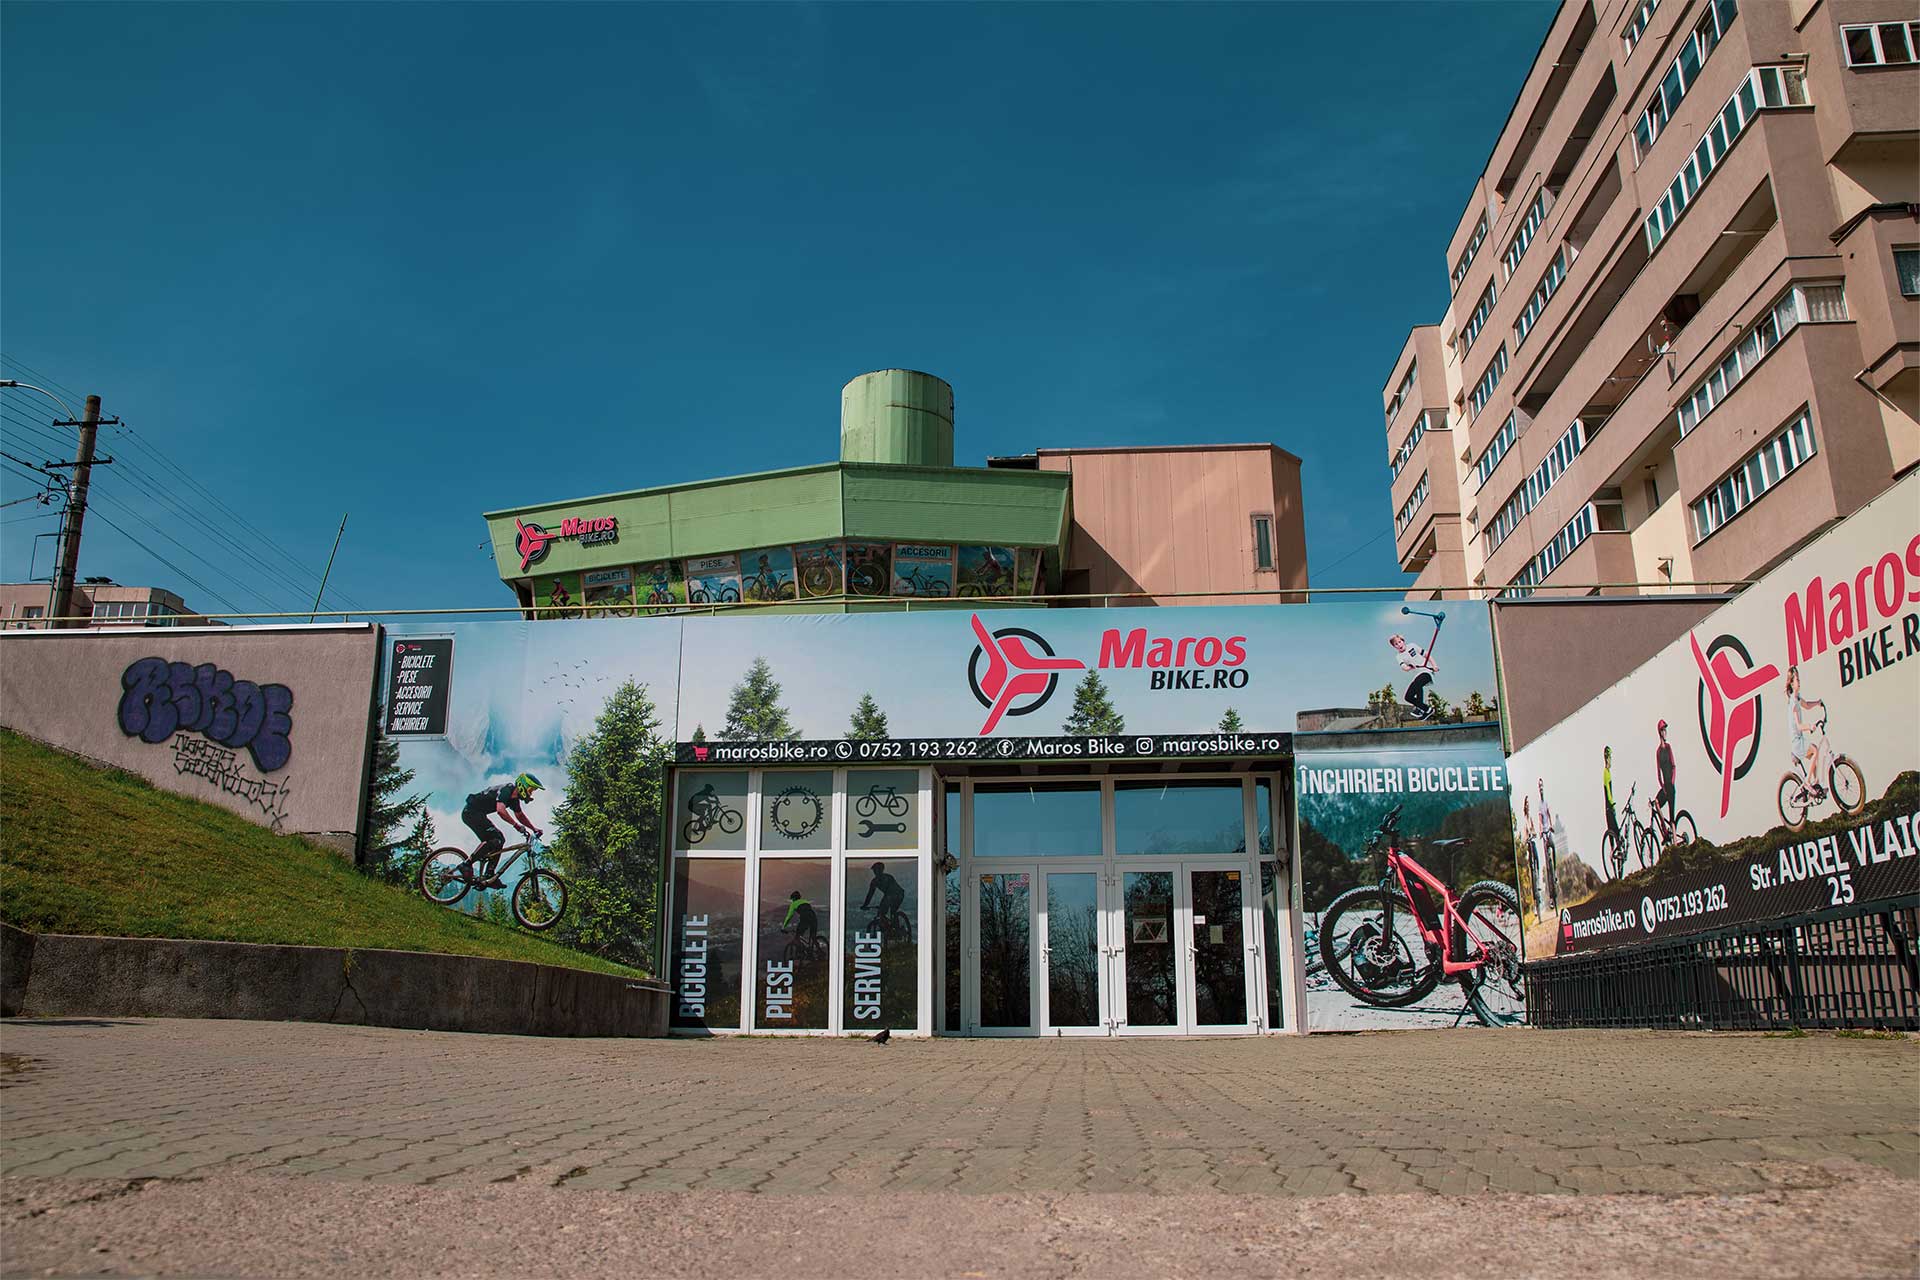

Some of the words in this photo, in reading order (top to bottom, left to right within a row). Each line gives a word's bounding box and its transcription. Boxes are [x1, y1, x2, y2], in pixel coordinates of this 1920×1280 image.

[561, 515, 615, 537] Maros
[579, 530, 615, 543] BIKE.RO
[700, 559, 722, 569] PIESE
[900, 547, 947, 557] ACCESORII
[589, 570, 625, 583] BICICLETE
[1098, 628, 1247, 669] Maros
[1150, 669, 1249, 690] BIKE.RO
[716, 743, 828, 759] marosbike.ro
[860, 743, 901, 757] 0752
[909, 742, 940, 756] 193
[946, 741, 977, 756] 262
[1027, 739, 1082, 755] Maros
[1088, 738, 1125, 754] Bike
[1163, 735, 1280, 752] marosbike.ro
[1299, 765, 1403, 794] ÎNCHIRIERI
[1408, 766, 1504, 793] BICICLETE
[1750, 863, 1777, 891] Str.
[1779, 835, 1850, 884] AUREL
[1827, 873, 1855, 905] 25
[1573, 908, 1636, 938] marosbike.ro
[1655, 895, 1682, 922] 0752
[1682, 889, 1703, 917] 193
[1704, 884, 1728, 912] 262
[679, 914, 709, 1018] BICICLETE
[853, 931, 882, 1020] SERVICE
[766, 960, 794, 1019] PIESE
